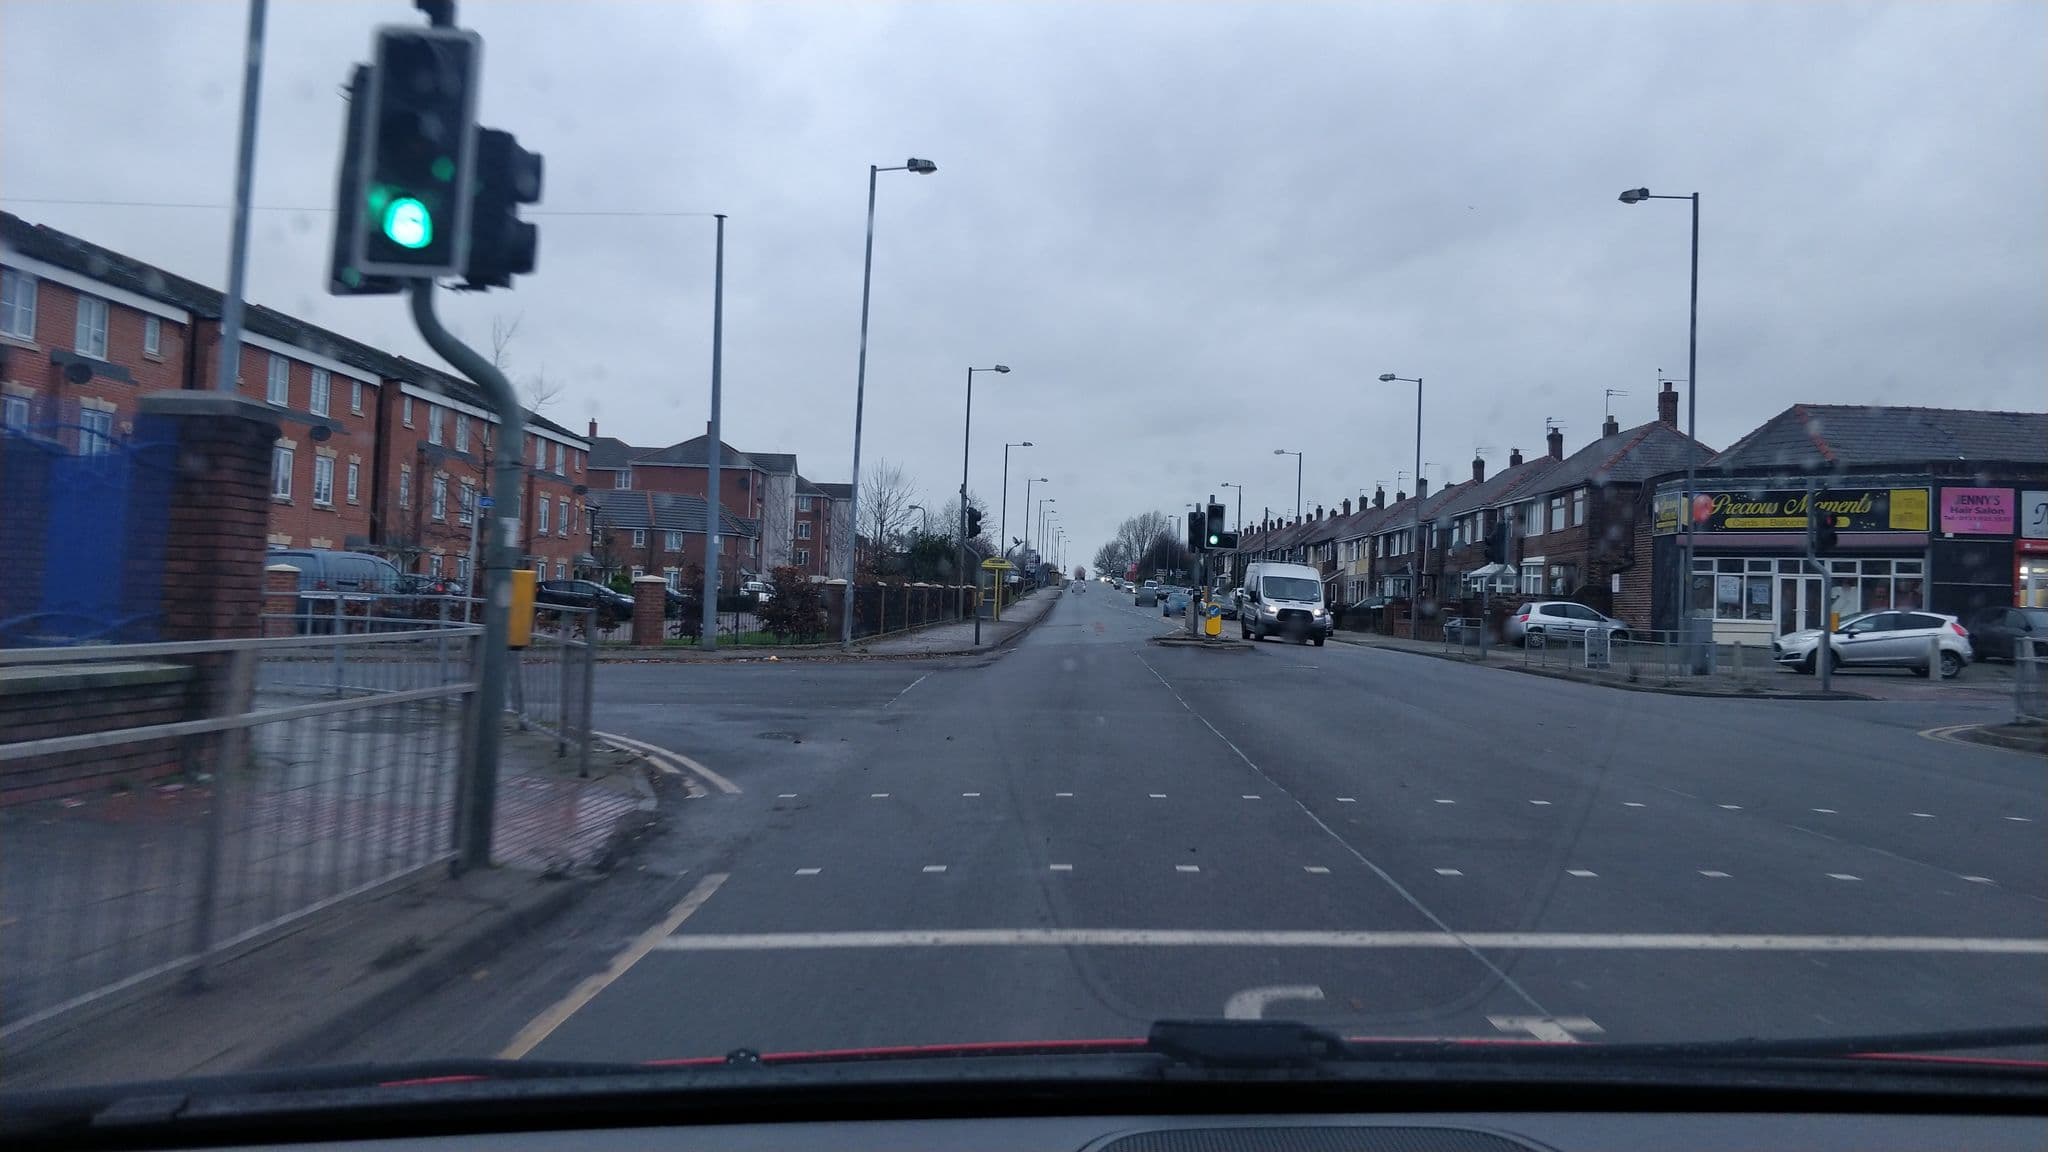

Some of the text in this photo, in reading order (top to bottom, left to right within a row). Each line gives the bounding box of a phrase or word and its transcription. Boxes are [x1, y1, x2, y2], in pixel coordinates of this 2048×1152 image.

[1708, 494, 1779, 515] Precious
[1955, 495, 2000, 506] JENNY'S
[1950, 506, 2006, 515] Hair Salon
